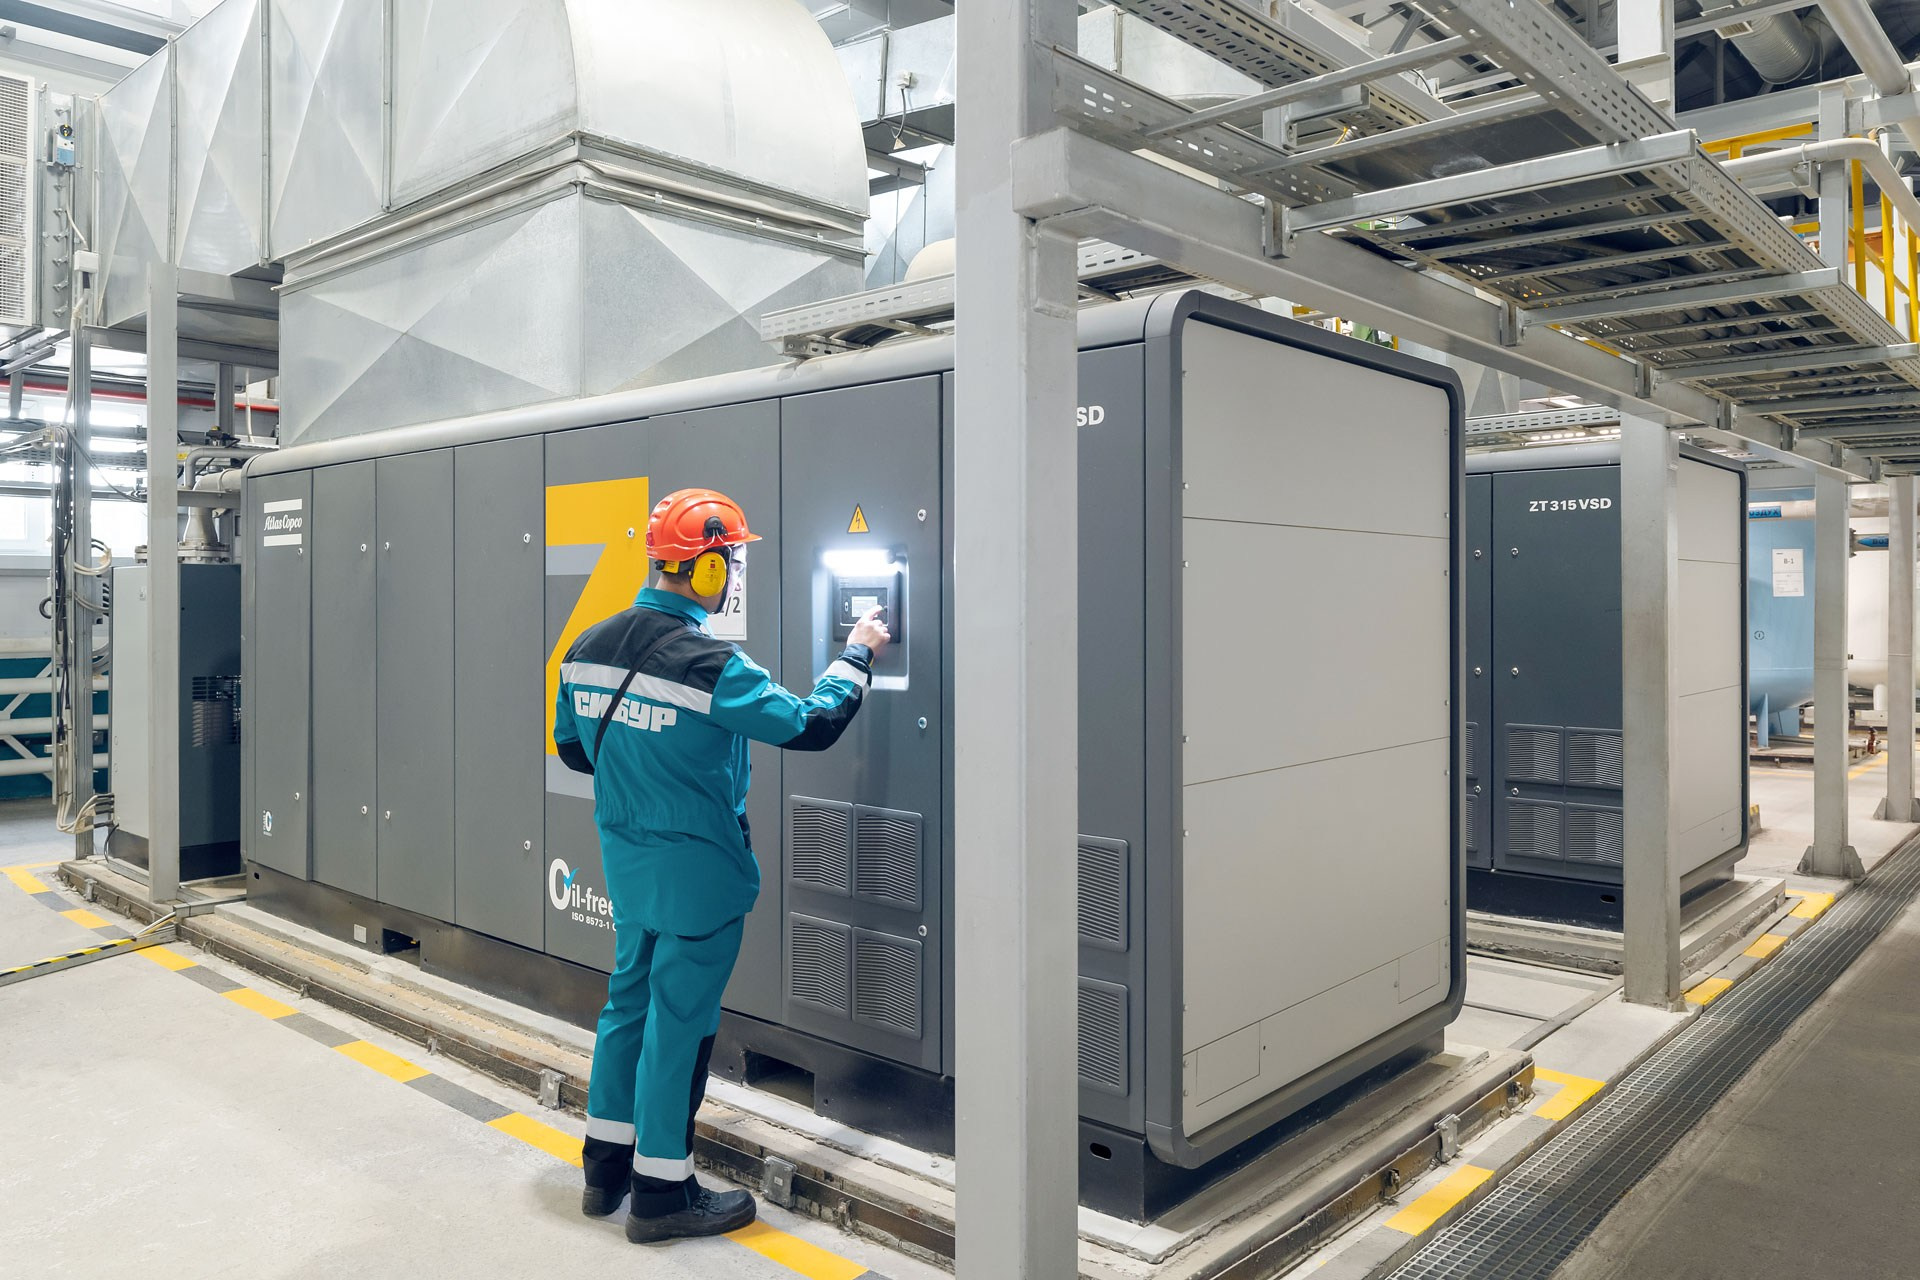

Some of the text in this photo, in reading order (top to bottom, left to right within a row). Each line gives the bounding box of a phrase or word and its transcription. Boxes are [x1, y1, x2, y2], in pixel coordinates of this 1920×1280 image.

[1529, 498, 1612, 512] ZT 315 VSD
[263, 514, 303, 532] Atlas Copco
[720, 596, 741, 616] /2
[573, 691, 678, 732] СИБУР
[571, 911, 585, 923] ISO
[585, 915, 610, 930] 8573-1
